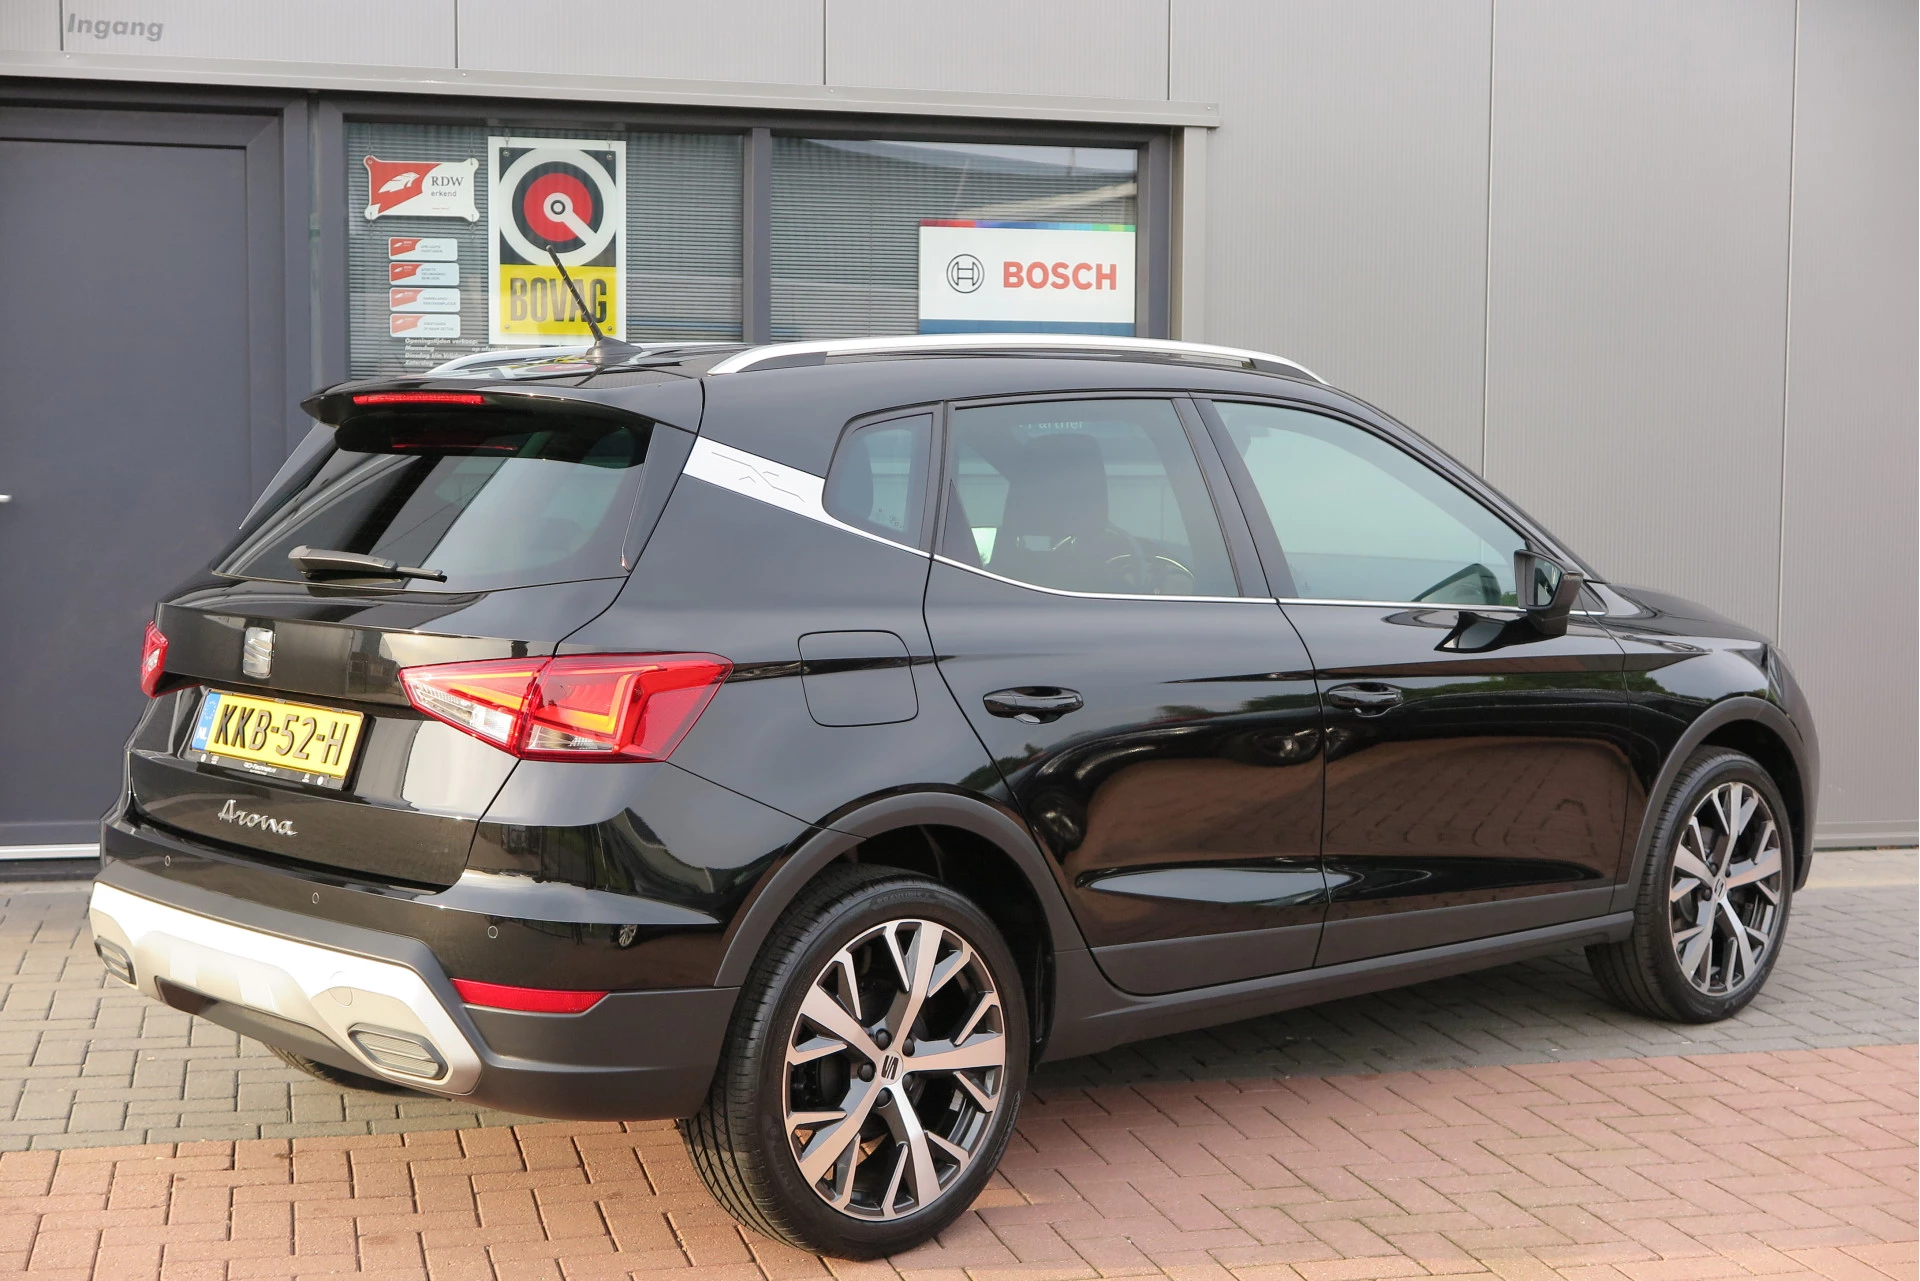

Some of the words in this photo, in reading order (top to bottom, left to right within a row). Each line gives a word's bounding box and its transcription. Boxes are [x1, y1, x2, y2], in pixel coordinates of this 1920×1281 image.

[67, 12, 165, 42] Ingang
[430, 175, 464, 187] RDW
[430, 190, 457, 198] erkend
[1003, 261, 1117, 290] BOSCH
[510, 277, 607, 324] BOVAG
[404, 345, 435, 353] Maandag
[196, 726, 208, 740] NL
[214, 704, 349, 766] KKB-52-H
[218, 799, 298, 837] Arona
